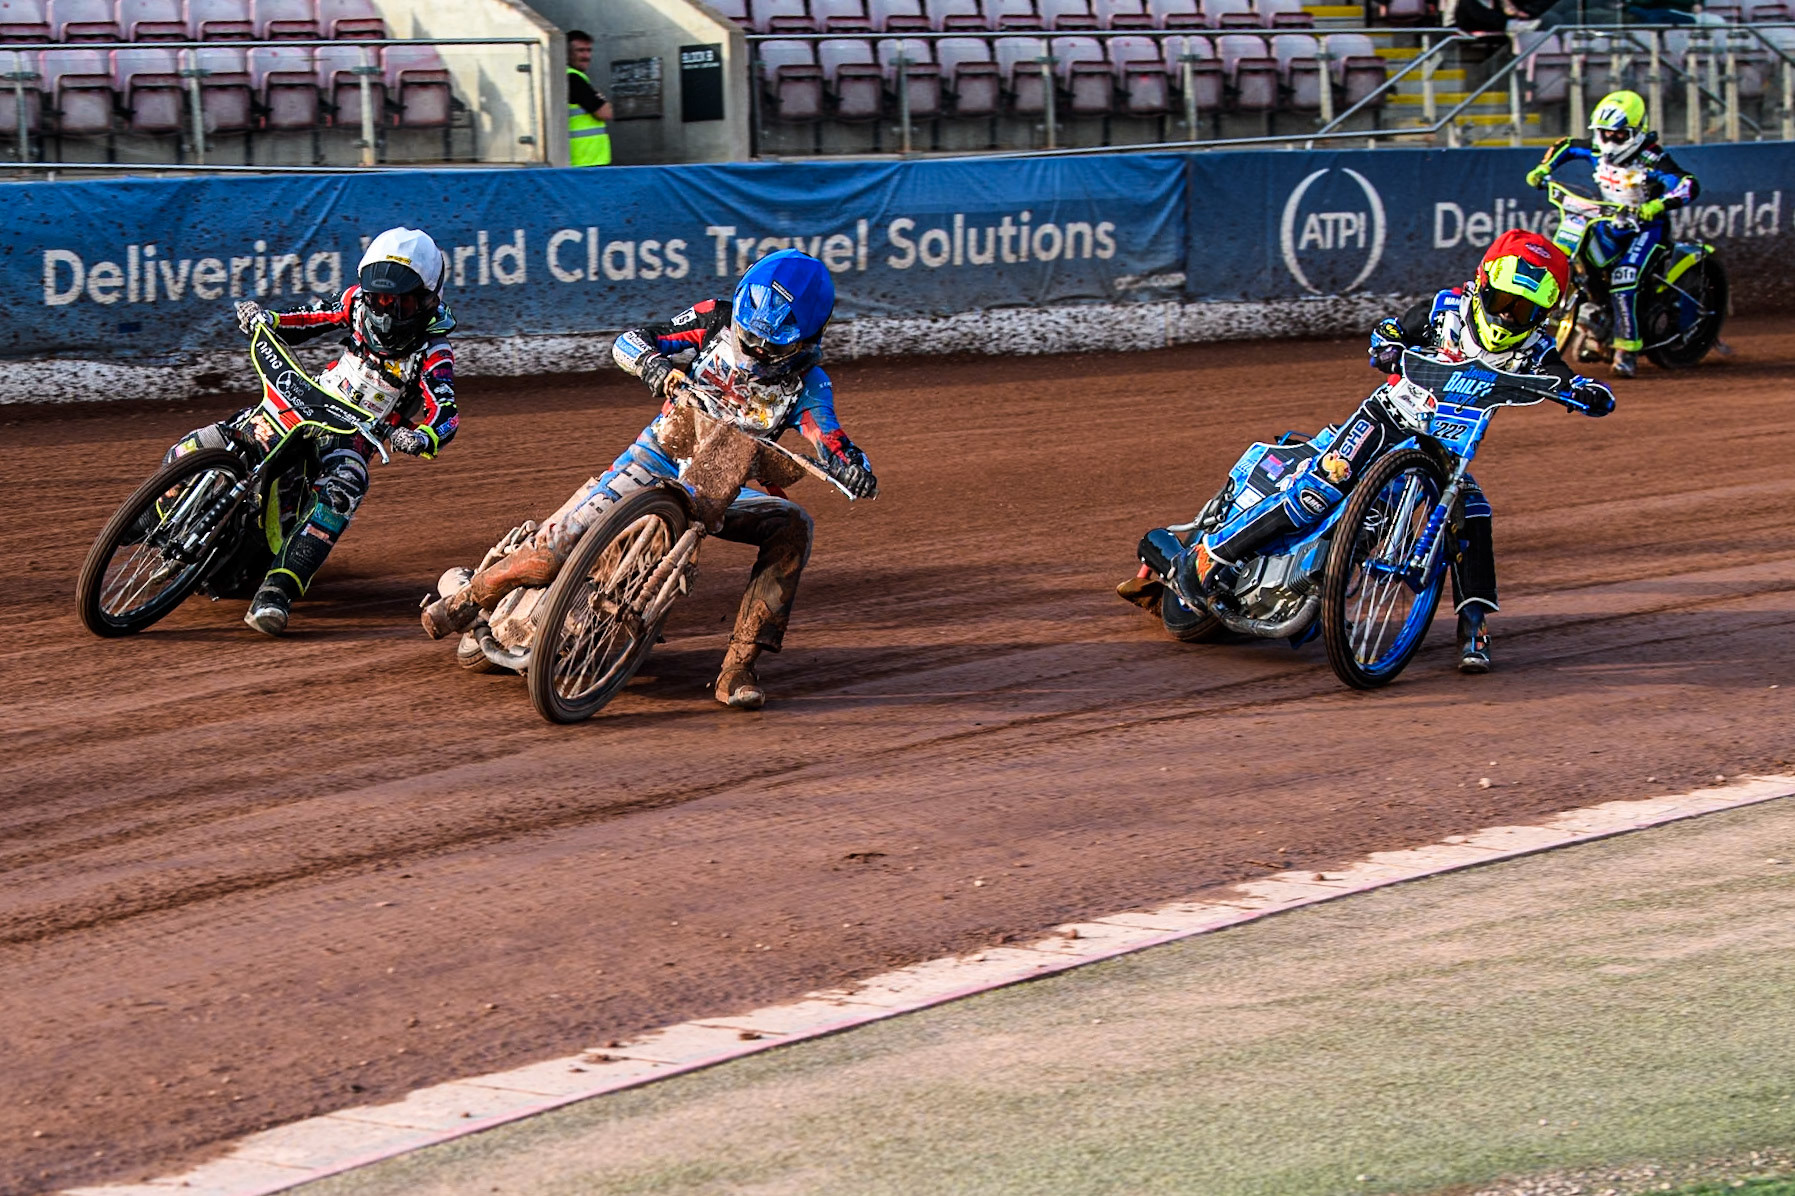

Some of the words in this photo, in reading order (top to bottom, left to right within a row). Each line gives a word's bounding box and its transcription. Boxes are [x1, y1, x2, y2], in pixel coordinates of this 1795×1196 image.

[1298, 211, 1367, 250] ATPI
[1671, 190, 1781, 240] world
[42, 239, 342, 306] Delivering
[360, 229, 527, 288] rld
[547, 226, 691, 283] Class
[887, 210, 1116, 270] Solutions
[284, 390, 315, 417] CLASSCS
[1340, 419, 1371, 458] SHB
